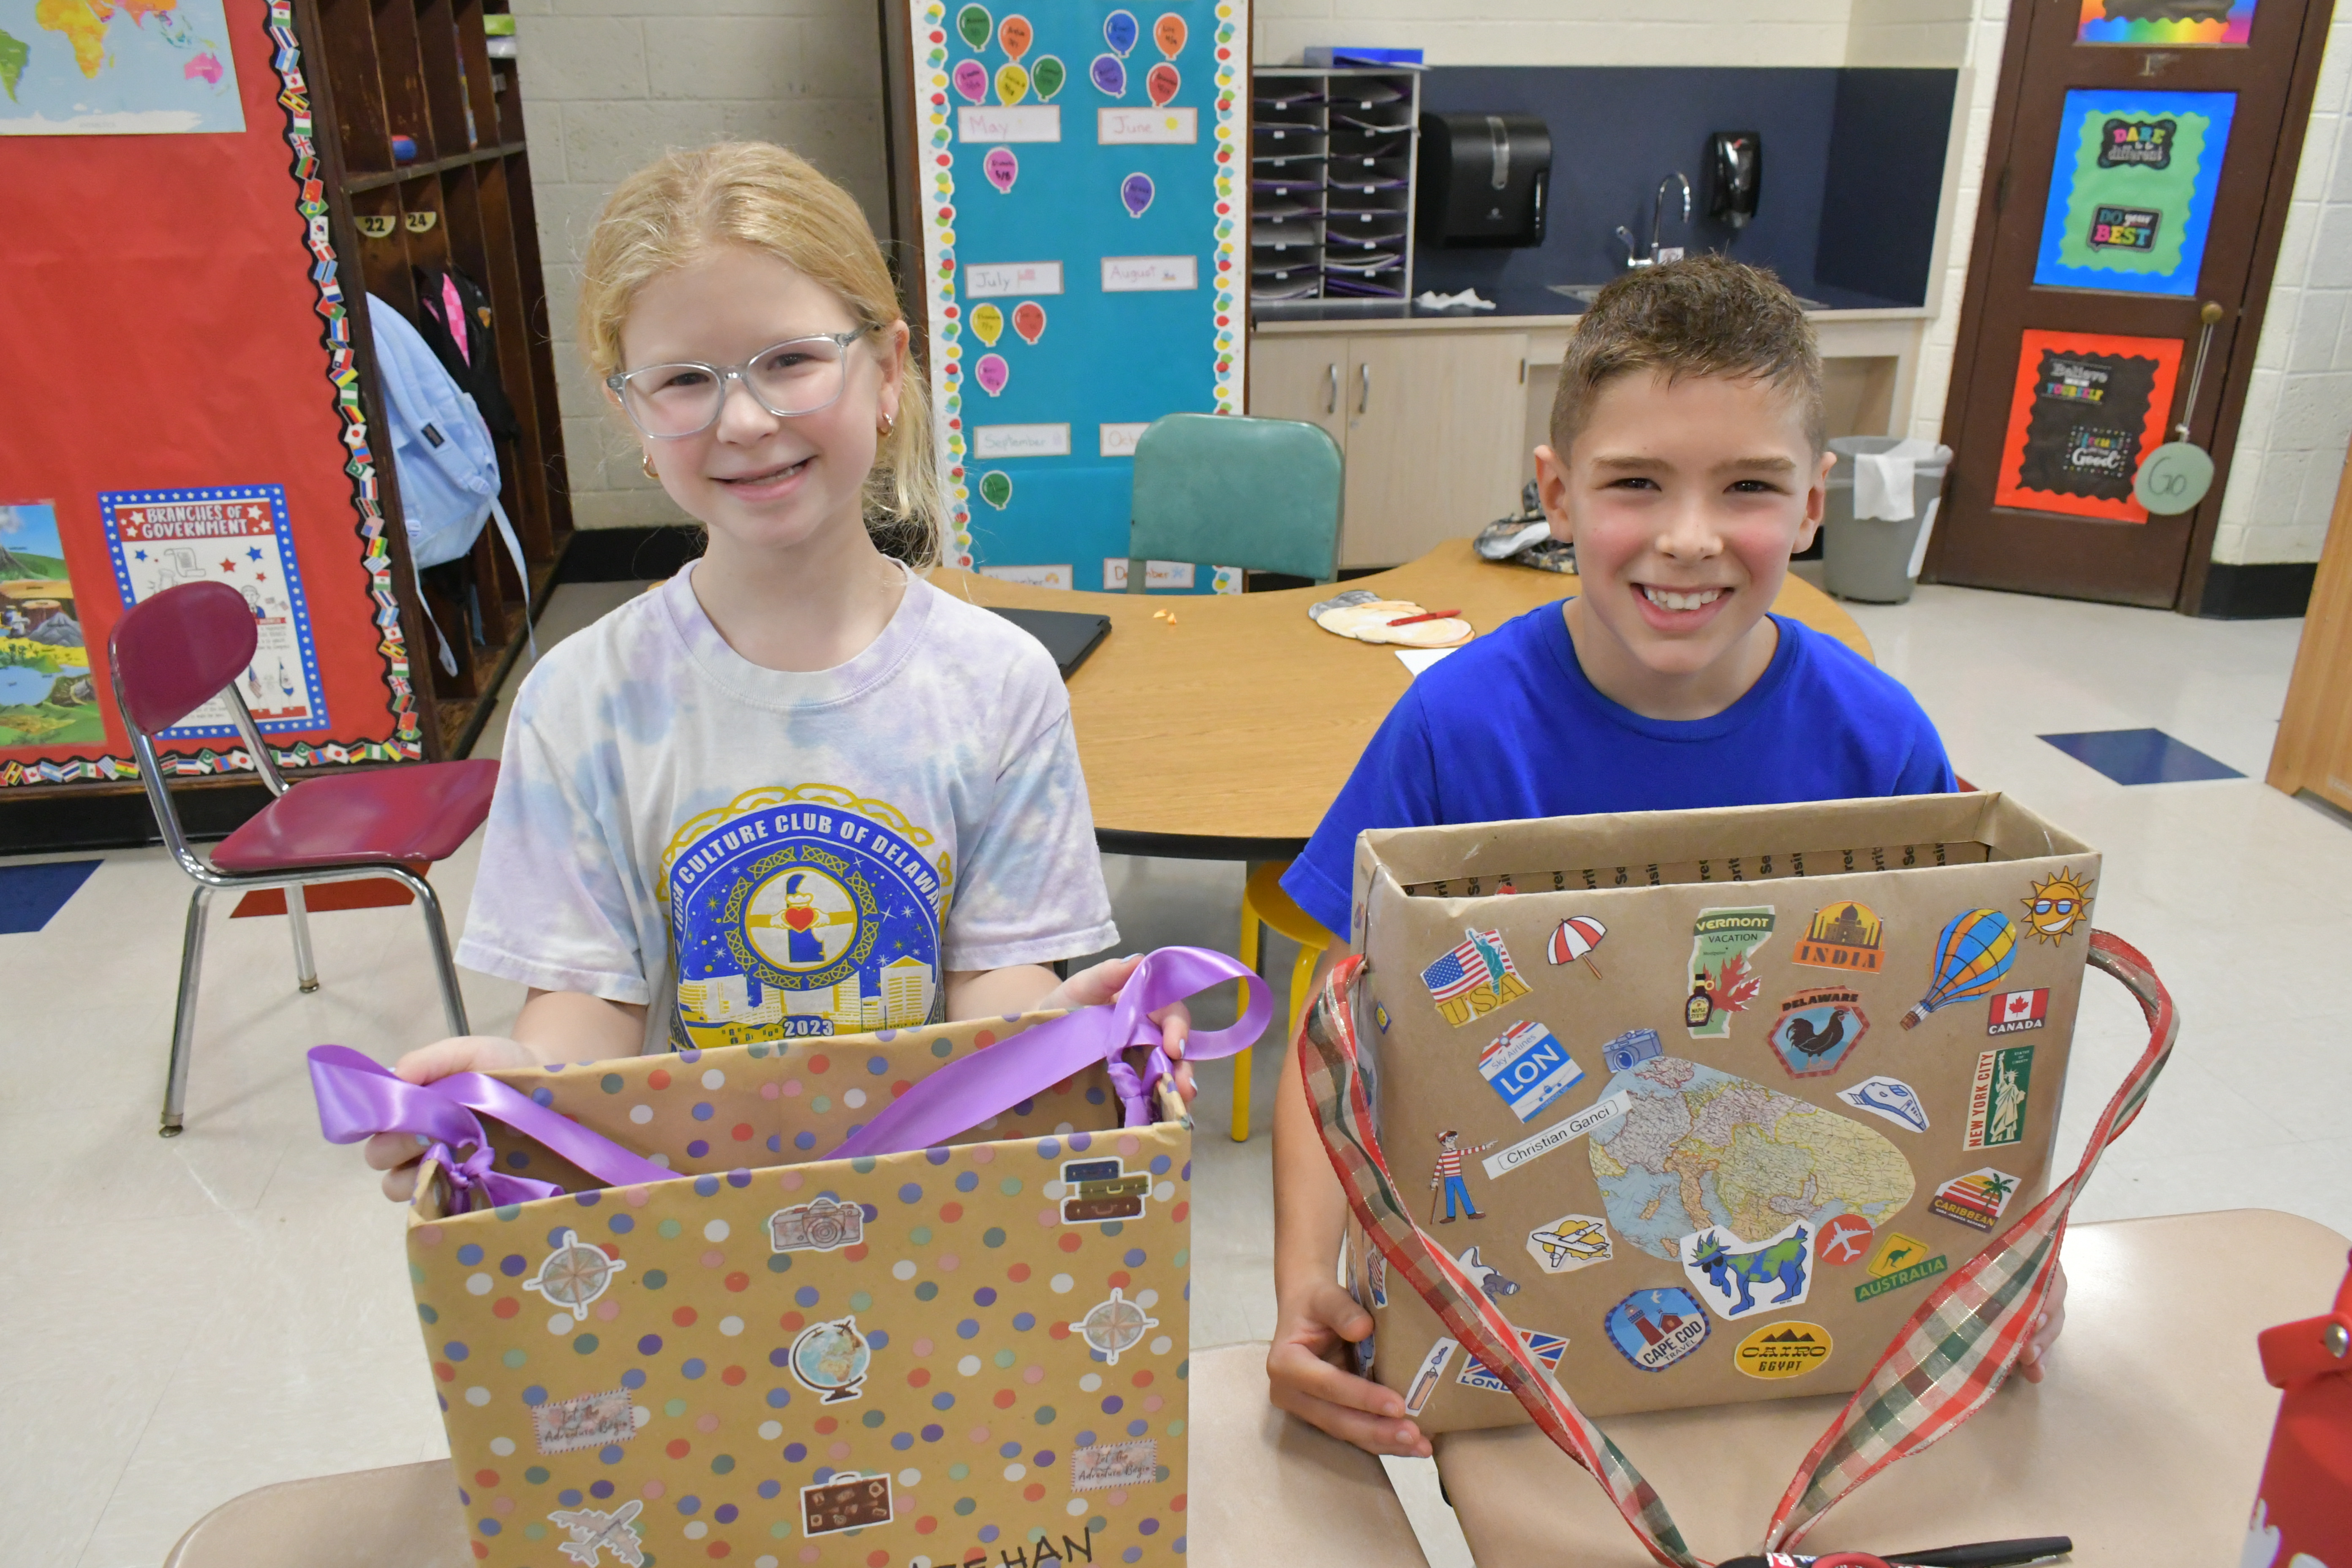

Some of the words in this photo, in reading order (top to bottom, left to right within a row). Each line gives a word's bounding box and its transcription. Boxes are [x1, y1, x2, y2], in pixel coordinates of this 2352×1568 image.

[1113, 115, 1152, 134] June
[2113, 126, 2166, 144] DARE
[365, 218, 384, 232] 22
[408, 214, 427, 228] 24
[2099, 209, 2123, 225] DO
[2094, 224, 2151, 247] BEST
[975, 271, 1010, 291] July
[2072, 447, 2119, 469] Good
[146, 505, 222, 523] BRANCHES
[227, 506, 242, 519] OF
[142, 519, 248, 539] GOVERNMENT
[678, 819, 768, 885] CULTURE
[775, 812, 832, 834] CLUB
[839, 820, 869, 844] OF
[1696, 917, 1769, 931] VERMONT
[1708, 933, 1758, 943] VACATION
[1800, 945, 1877, 969] INDIA
[1437, 972, 1530, 1025] USA
[1782, 993, 1859, 1012] DELAWARE
[784, 1019, 834, 1037] 2023
[1988, 1019, 2042, 1035] CANADA
[1492, 1056, 1507, 1070] Sky
[1507, 1034, 1537, 1058] Airlines
[1500, 1043, 1560, 1096] LON
[1977, 1054, 1994, 1081] CITY
[1972, 1084, 1988, 1117] YORK
[1506, 1129, 1568, 1164] Christian
[1569, 1105, 1611, 1133] Ganci
[1968, 1120, 1983, 1148] NEW
[1935, 1199, 1995, 1226] CARIBBEAN
[1859, 1258, 1945, 1298] AUSTRALIA
[1643, 1335, 1680, 1366] CAPE
[1677, 1320, 1702, 1344] COD
[1664, 1339, 1697, 1361] TRAVEL
[1742, 1346, 1826, 1358] CAIRO
[1460, 1375, 1512, 1392] LOND
[1078, 1467, 1122, 1481] Adventure
[1125, 1464, 1150, 1478] Begin
